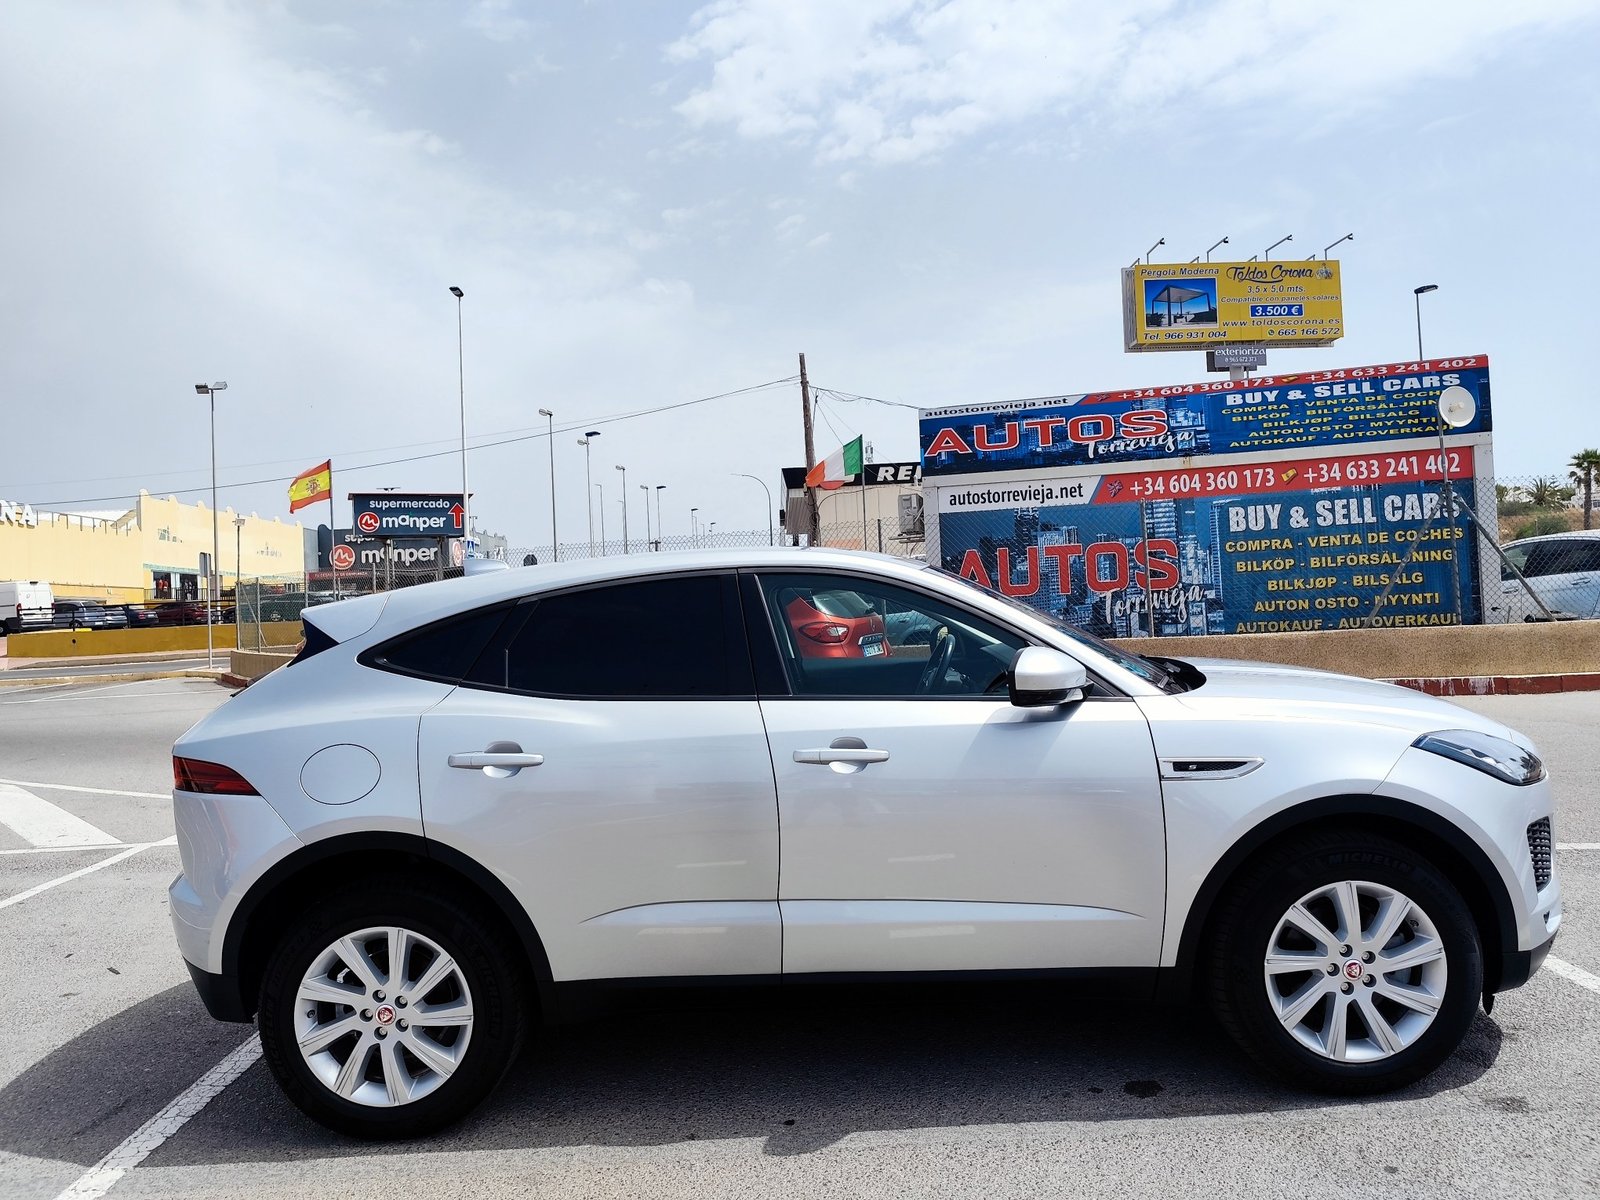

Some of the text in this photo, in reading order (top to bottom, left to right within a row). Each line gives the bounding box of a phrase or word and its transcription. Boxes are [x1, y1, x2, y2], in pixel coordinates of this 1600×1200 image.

[1179, 267, 1220, 275] Moderna
[1226, 264, 1314, 283] Toldos Corona
[1221, 296, 1264, 304] Compatible
[1255, 306, 1299, 316] 3.500 €
[1164, 332, 1183, 340] 966
[1278, 327, 1340, 336] 665 166 572
[1215, 347, 1266, 356] exterioriza
[1306, 358, 1477, 382] +34 633 241 402
[1118, 377, 1274, 399] +34 604 360 173
[1226, 373, 1460, 406] BUY & SELL CARS
[924, 398, 1068, 418] autostorrevieja.net
[1221, 403, 1289, 415] COMPRA
[1305, 397, 1359, 408] VENTA
[1232, 410, 1290, 422] BILKÖP
[1263, 417, 1332, 428] BILKJØP
[1349, 410, 1421, 420] BILSALG
[924, 409, 1168, 457] AUTOS
[1248, 428, 1304, 438] AUTON
[1310, 423, 1354, 432] OSTO
[1370, 417, 1436, 427] MYYNTI
[1081, 431, 1194, 458] Torrevieja
[1230, 434, 1317, 448] AUTOKAUF
[1304, 462, 1341, 483] +34
[1346, 459, 1380, 480] 633
[1386, 456, 1418, 477] 241
[1130, 468, 1275, 495] +34 604 360 173
[369, 498, 450, 510] supermercado
[949, 483, 1083, 506] autostorrevieja.net
[382, 511, 446, 531] manper
[1228, 504, 1282, 532] BUY
[1290, 506, 1310, 528] &
[1316, 498, 1377, 526] SELL
[1225, 538, 1294, 552] COMPRA
[1308, 533, 1362, 548] VENTA
[1368, 532, 1388, 544] DE
[960, 538, 1179, 597] AUTOS
[1236, 556, 1295, 572] BILKÖP
[1310, 549, 1453, 568] BILFÖRSÄLNING
[1267, 576, 1337, 591] BILKJØP
[1254, 599, 1309, 612] AUTON
[1314, 597, 1359, 609] OSTO
[1236, 619, 1323, 633] AUTOKAUF
